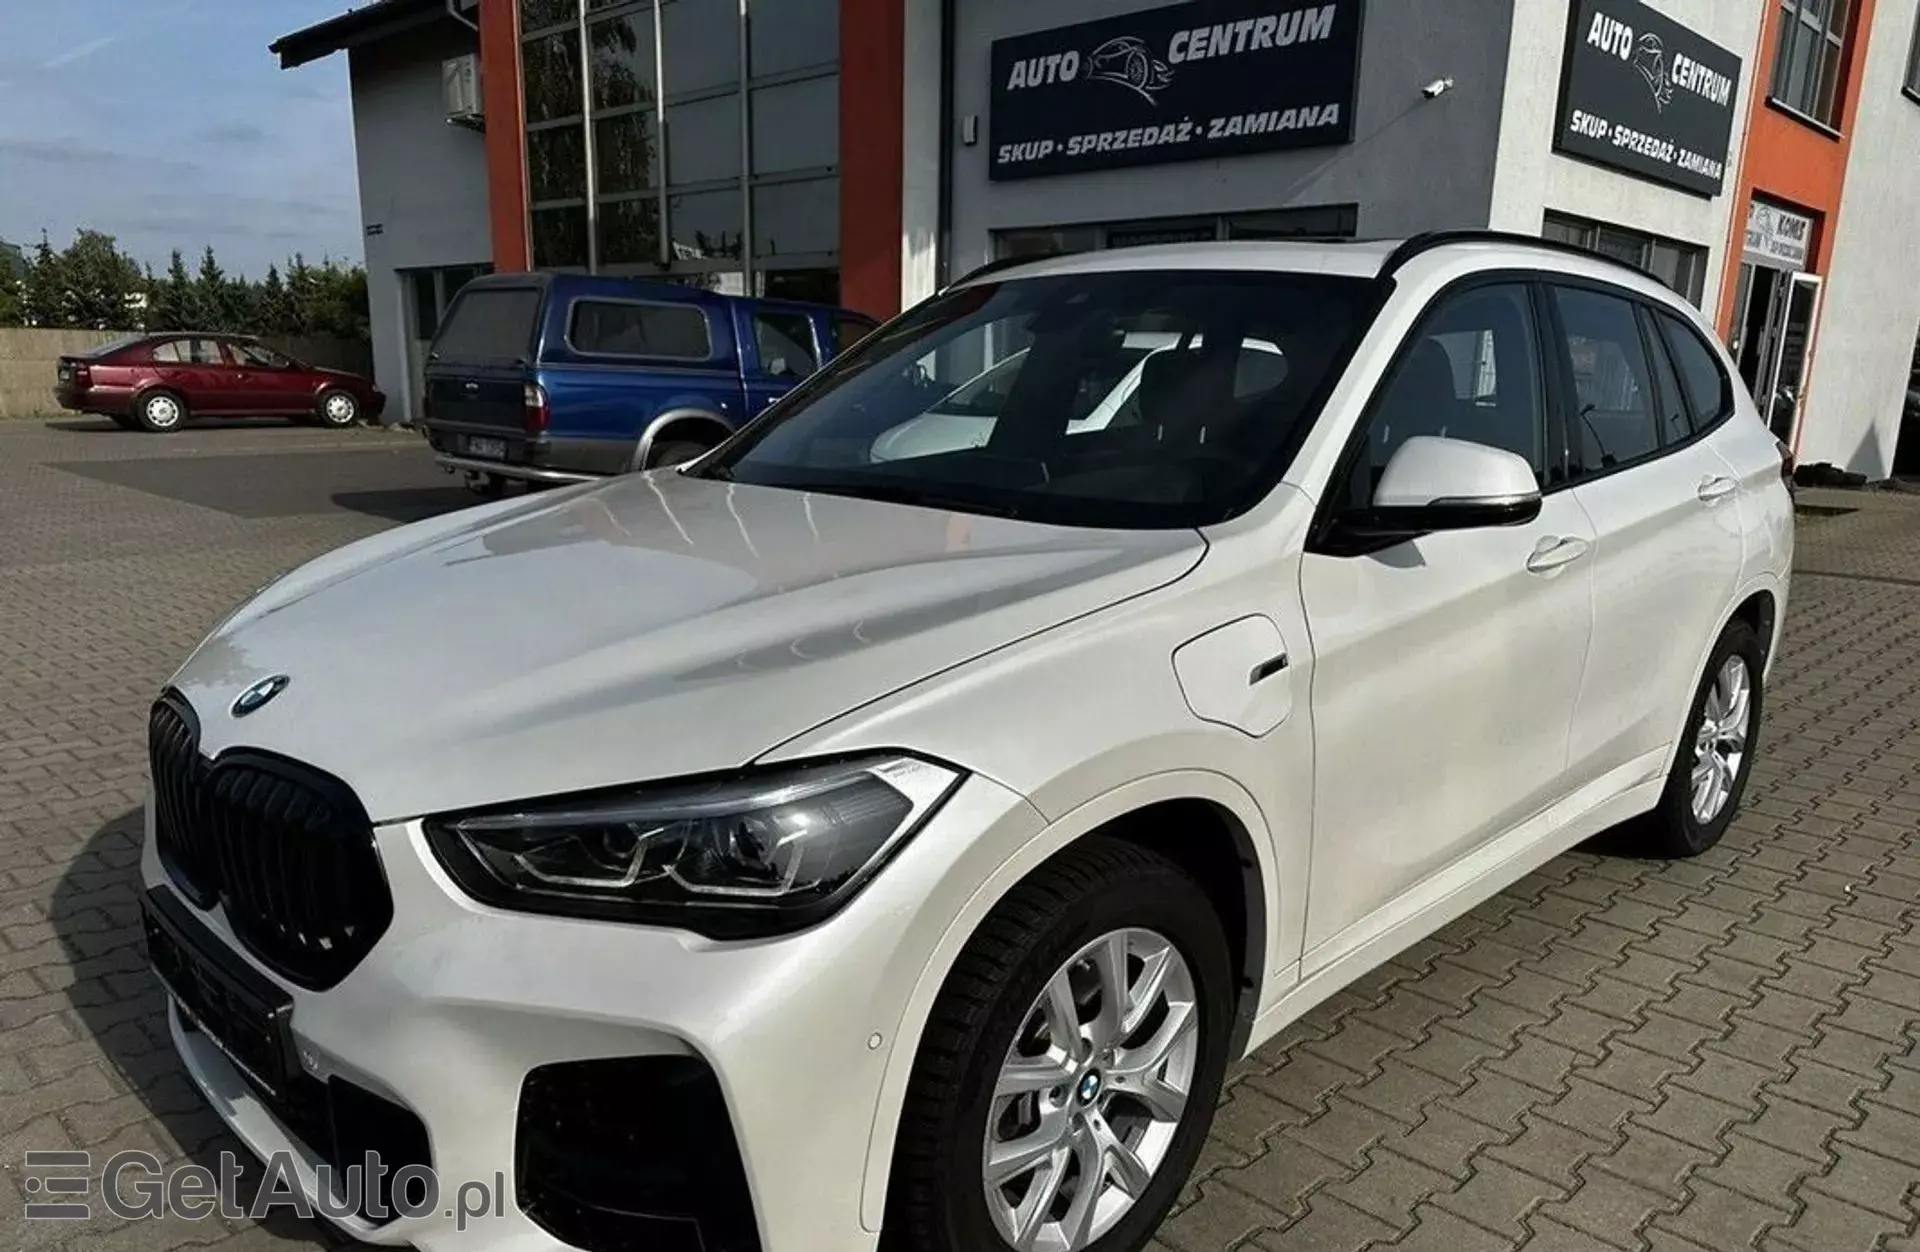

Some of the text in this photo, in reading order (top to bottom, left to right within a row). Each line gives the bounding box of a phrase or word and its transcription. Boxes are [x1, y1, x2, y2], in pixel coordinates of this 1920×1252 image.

[1007, 4, 1336, 91] AUTO CENTRUM
[1587, 11, 1732, 106] AUTO CENTRUM
[998, 103, 1340, 164] SKUP SPRZEDAŻ ZAMIANA
[1570, 109, 1722, 180] SKUP SPRZEDAŻ ZAMIANA
